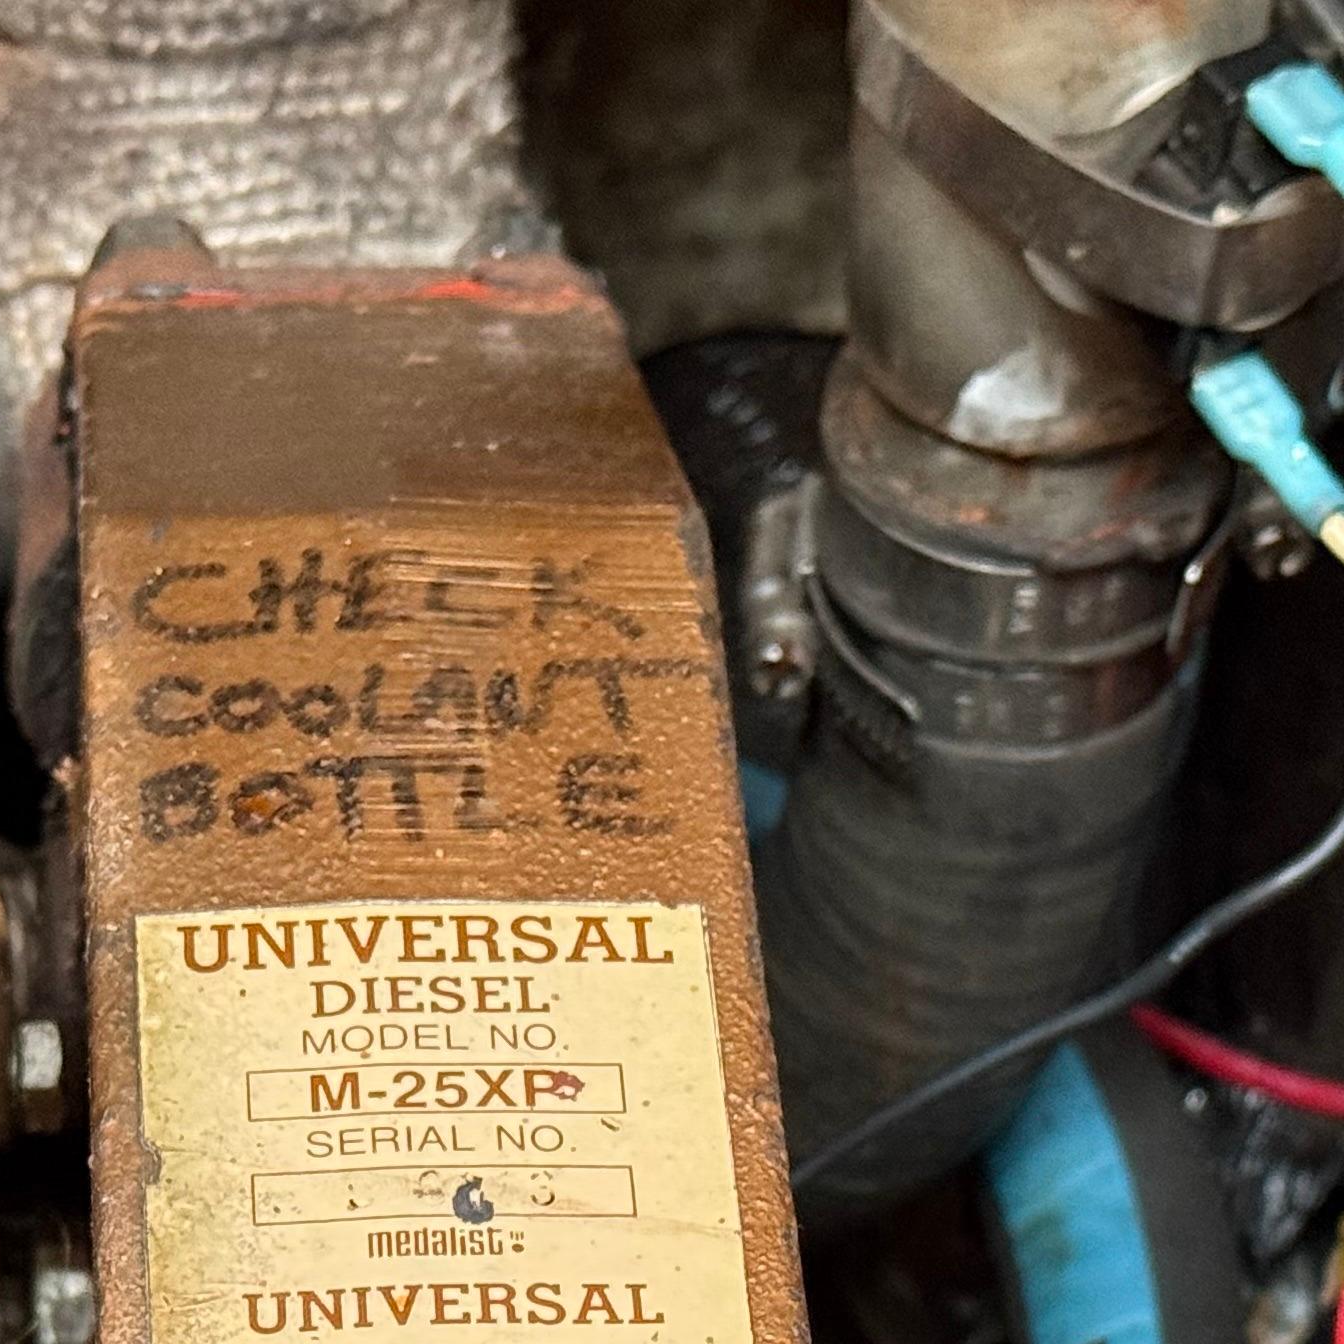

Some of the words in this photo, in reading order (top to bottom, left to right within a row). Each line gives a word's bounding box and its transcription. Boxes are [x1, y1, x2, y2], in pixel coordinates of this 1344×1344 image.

[140, 752, 672, 842] BOTTLE
[177, 914, 675, 974] UNIVERSAL
[309, 975, 551, 1018] DIESEL
[301, 1023, 470, 1056] MODEL
[489, 1022, 571, 1053] NO.
[305, 1125, 476, 1159] SERIAL
[495, 1124, 578, 1154] NO.
[366, 1226, 504, 1260] medalist
[242, 1282, 666, 1335] UNIVERSAL
